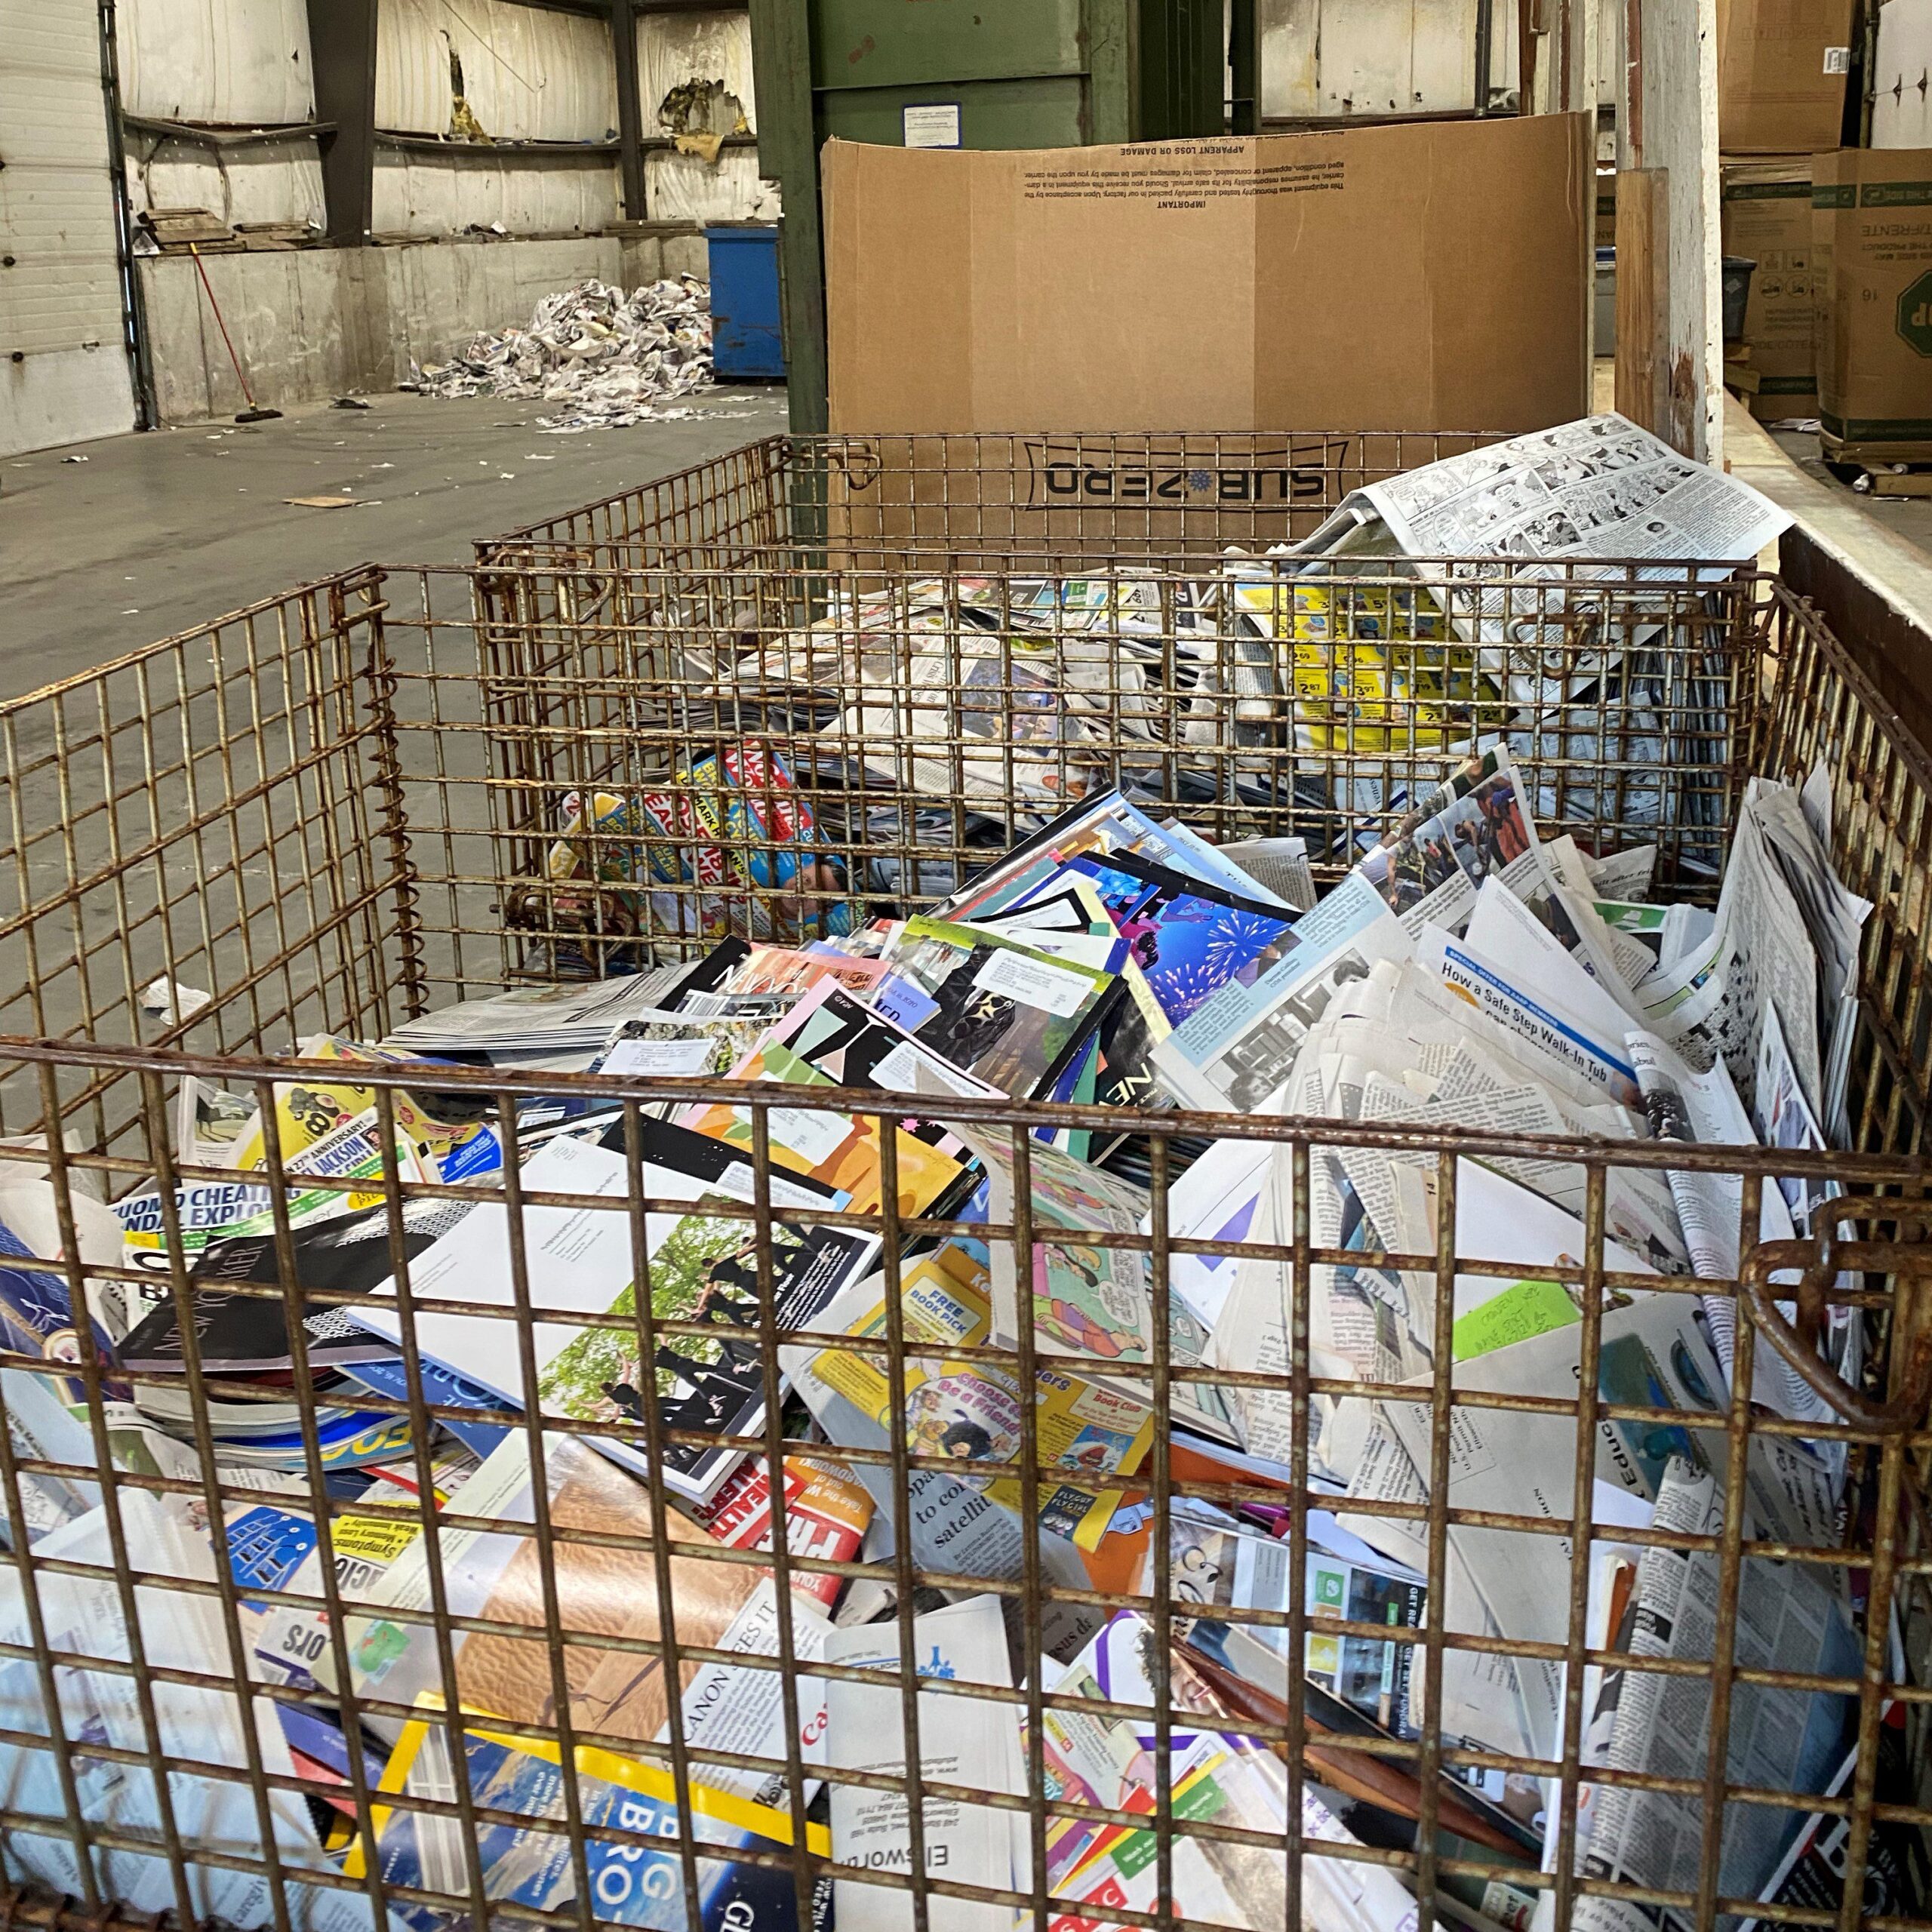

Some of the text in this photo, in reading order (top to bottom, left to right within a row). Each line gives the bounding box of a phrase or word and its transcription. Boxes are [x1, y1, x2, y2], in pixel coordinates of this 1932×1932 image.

[1120, 146, 1244, 156] APPARENT LOSS OR DAMAGE
[1263, 165, 1292, 174] apparent
[1084, 190, 1101, 198] Upon
[1234, 178, 1278, 186] responsibility
[1294, 183, 1328, 192] equipment
[1157, 200, 1205, 208] IMPORTANT
[1862, 289, 1878, 301] 16
[1042, 463, 1324, 500] SUB ZERO
[691, 795, 718, 829] MARK
[1448, 949, 1559, 1027] SPECIAL OFFER FOR AARP MEMBERS
[1442, 961, 1607, 1084] How a Safe Step Walk-In Tub
[309, 1118, 368, 1160] ANNIVERSARY!
[314, 1134, 367, 1177] JACKSON
[1426, 1183, 1436, 1195] 14
[776, 1270, 797, 1294] Floor
[906, 1287, 970, 1336] BOOK PICK
[926, 1288, 968, 1320] FREE
[937, 1379, 961, 1396] Be
[961, 1389, 977, 1403] a
[957, 1371, 1006, 1404] Choose
[1092, 1392, 1142, 1414] Book Club
[1456, 1424, 1474, 1454] Permit
[1597, 1421, 1640, 1488] Educ
[813, 1472, 845, 1493] out of
[820, 1487, 863, 1515] Take the
[1051, 1497, 1068, 1508] FLY
[1058, 1491, 1074, 1500] FLY
[913, 1501, 940, 1525] to
[337, 1526, 396, 1543] Memory Loss
[350, 1515, 418, 1536] Weak Immunity
[1408, 1587, 1418, 1607] GET
[753, 1600, 779, 1626] IT
[532, 1770, 546, 1795] ever
